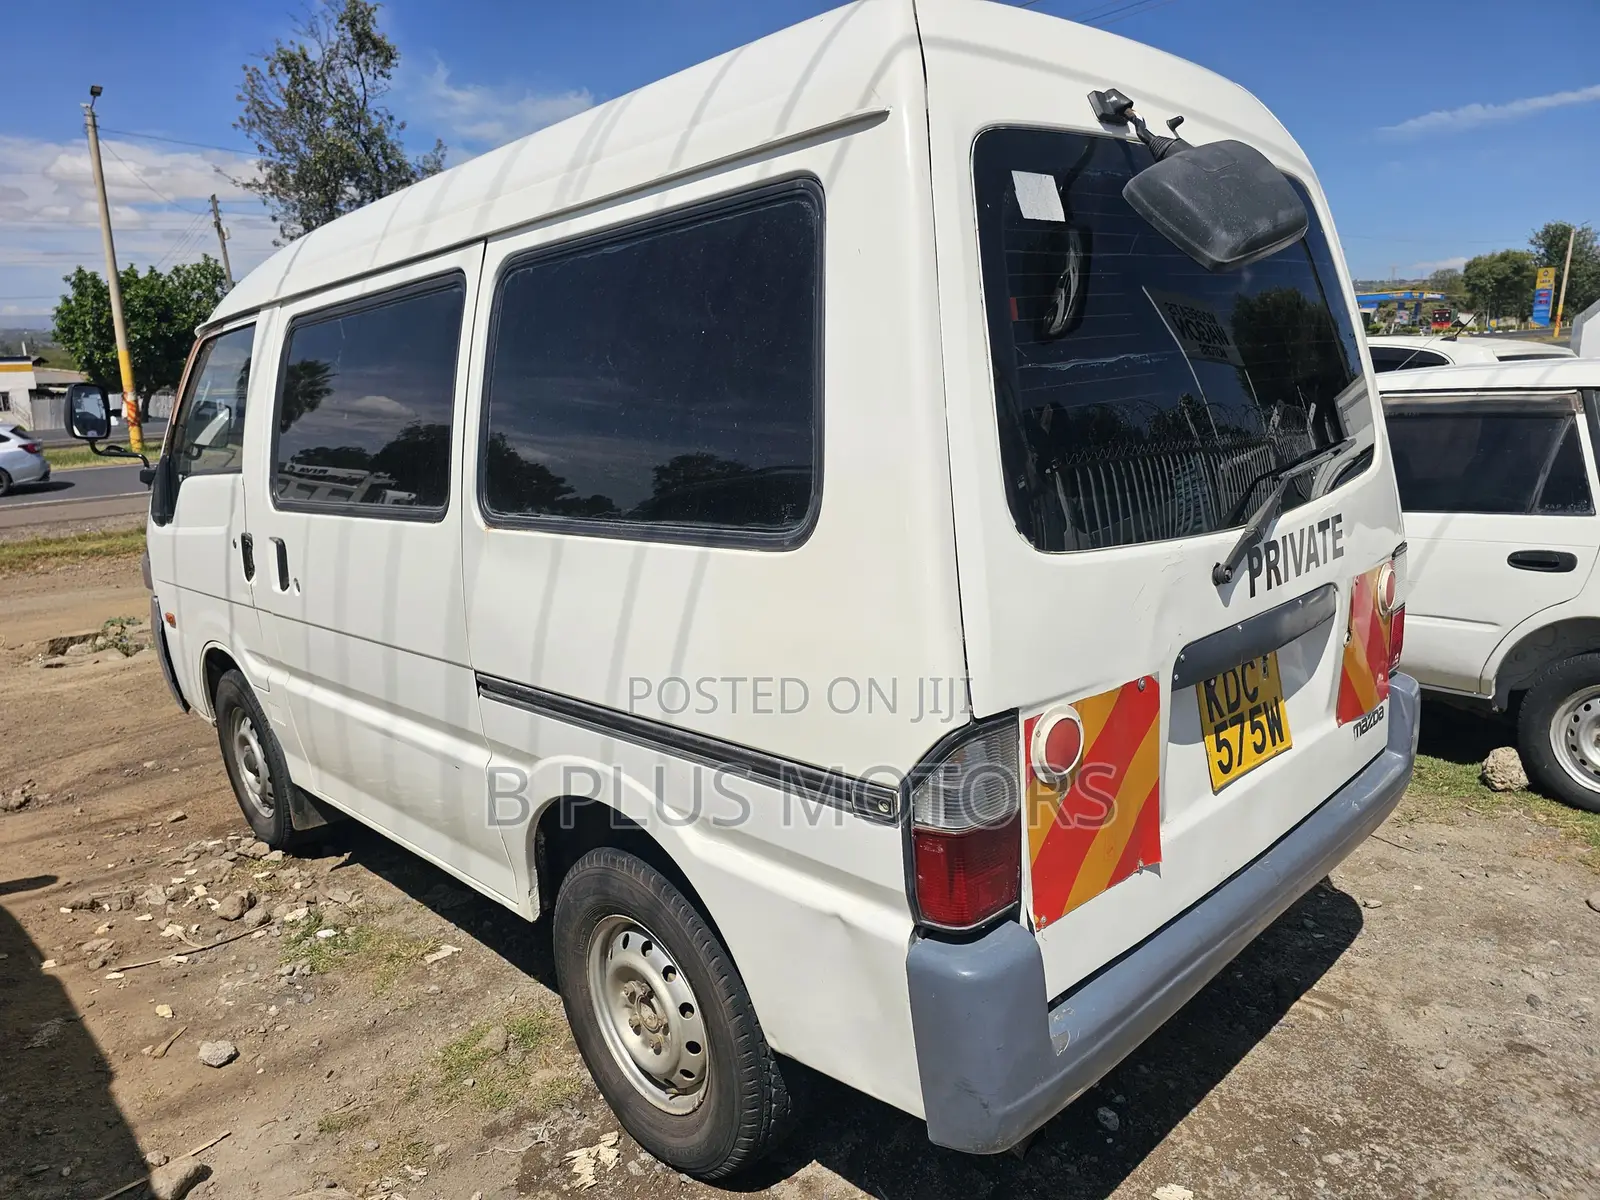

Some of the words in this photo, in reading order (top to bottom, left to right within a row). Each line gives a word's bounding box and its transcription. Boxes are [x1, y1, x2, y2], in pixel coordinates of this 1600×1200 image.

[1249, 513, 1344, 598] PRIVATE
[1204, 660, 1258, 723] KDC
[1213, 697, 1285, 775] 575W
